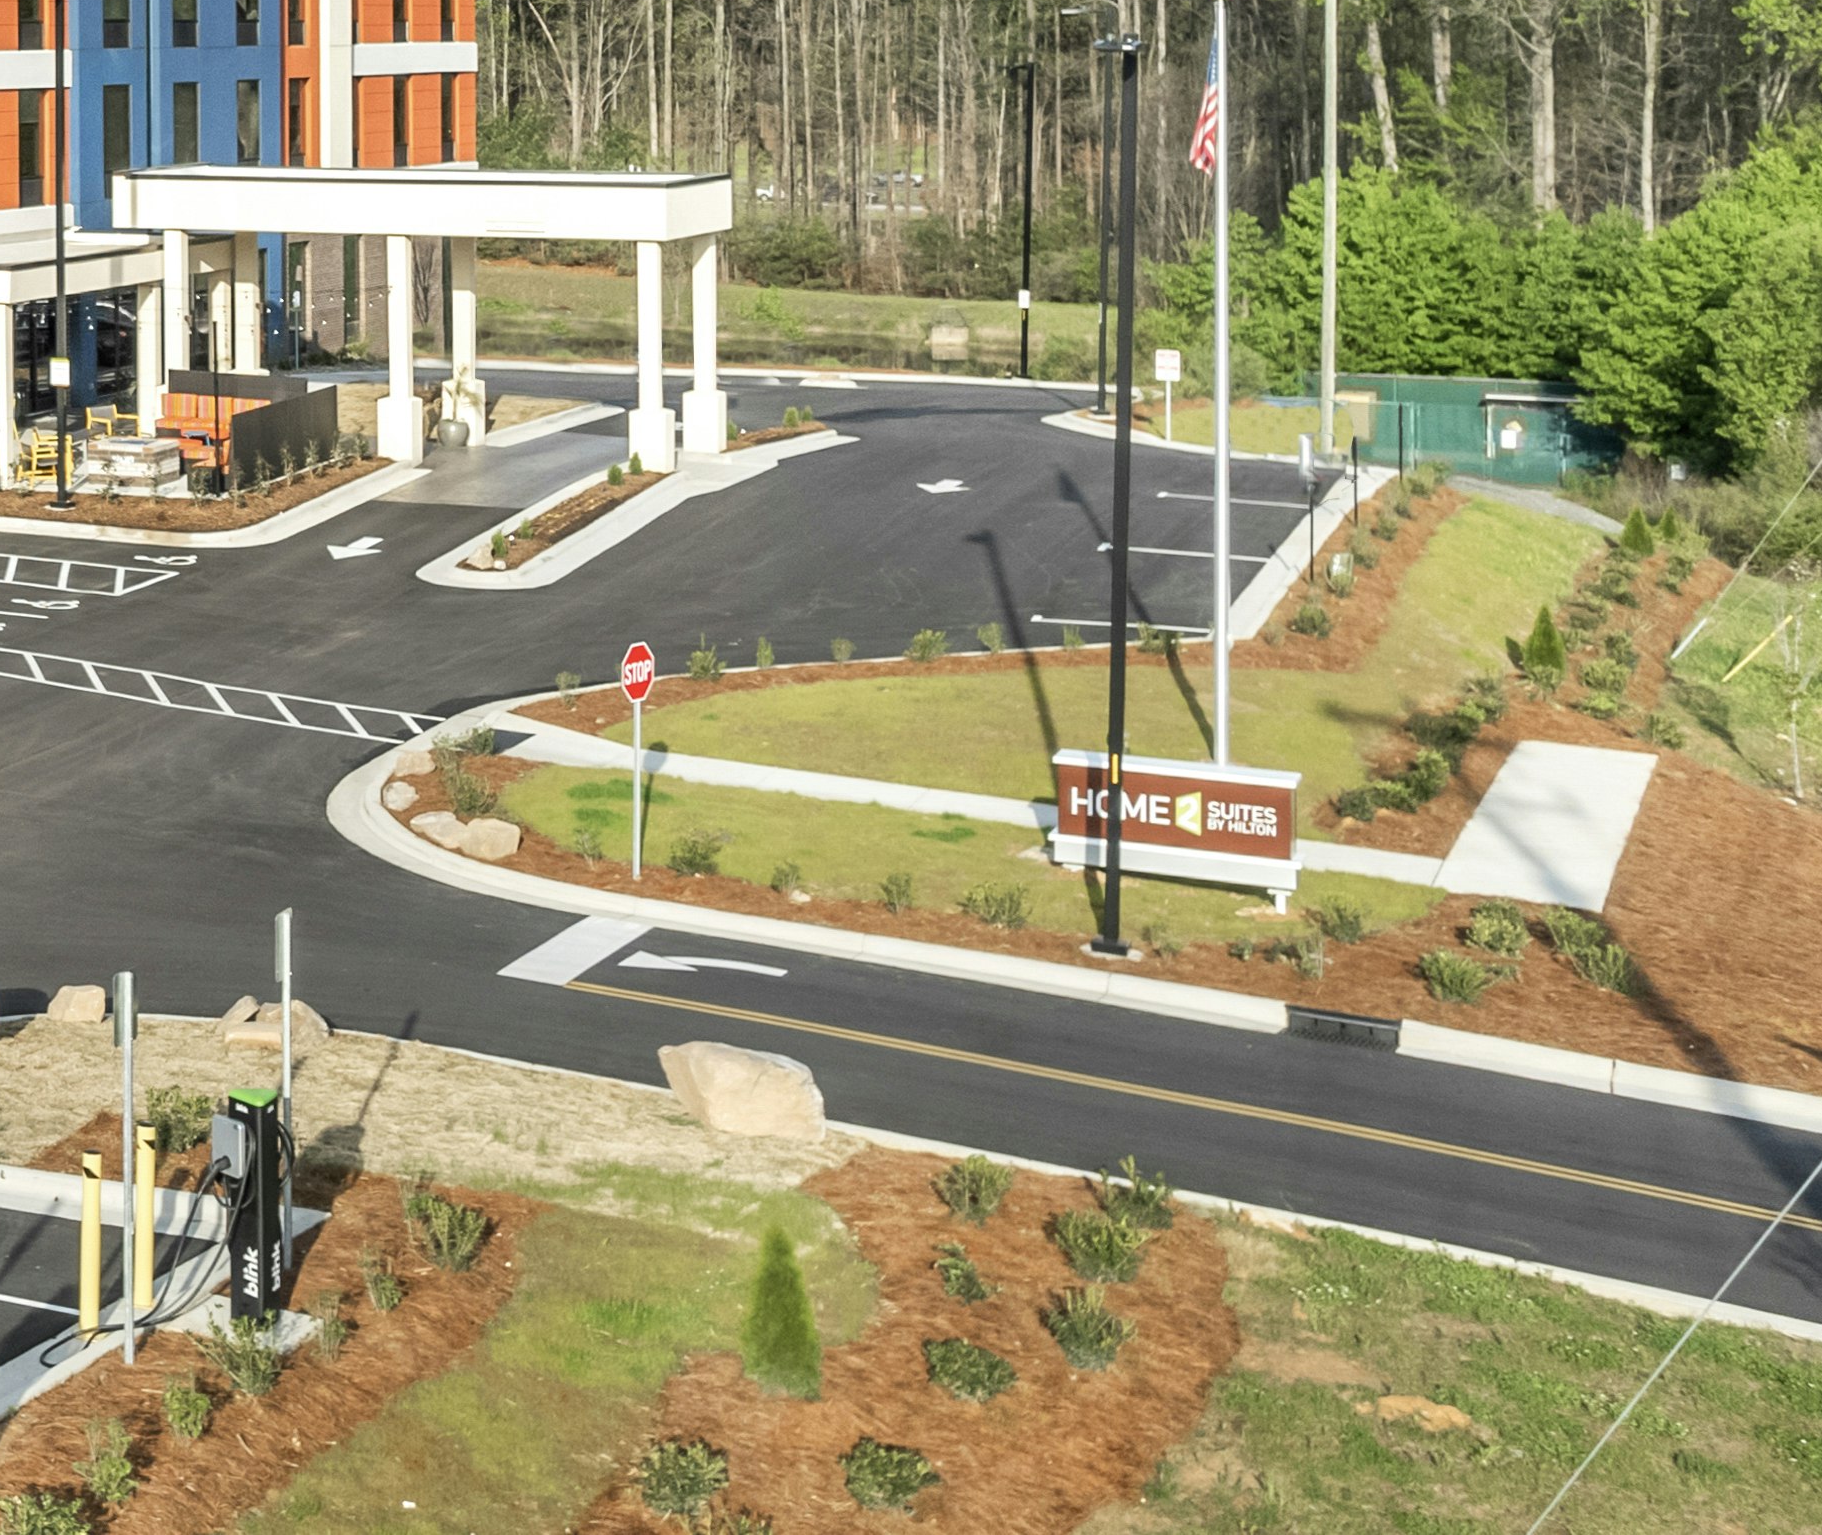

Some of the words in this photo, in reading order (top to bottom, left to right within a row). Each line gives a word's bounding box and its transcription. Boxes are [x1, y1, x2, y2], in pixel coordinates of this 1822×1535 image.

[624, 659, 652, 686] STOP
[1207, 800, 1277, 825] SUITES
[1207, 817, 1224, 831] BY
[1227, 819, 1277, 837] HILTON
[242, 1246, 259, 1299] blink
[271, 1239, 281, 1292] blink
